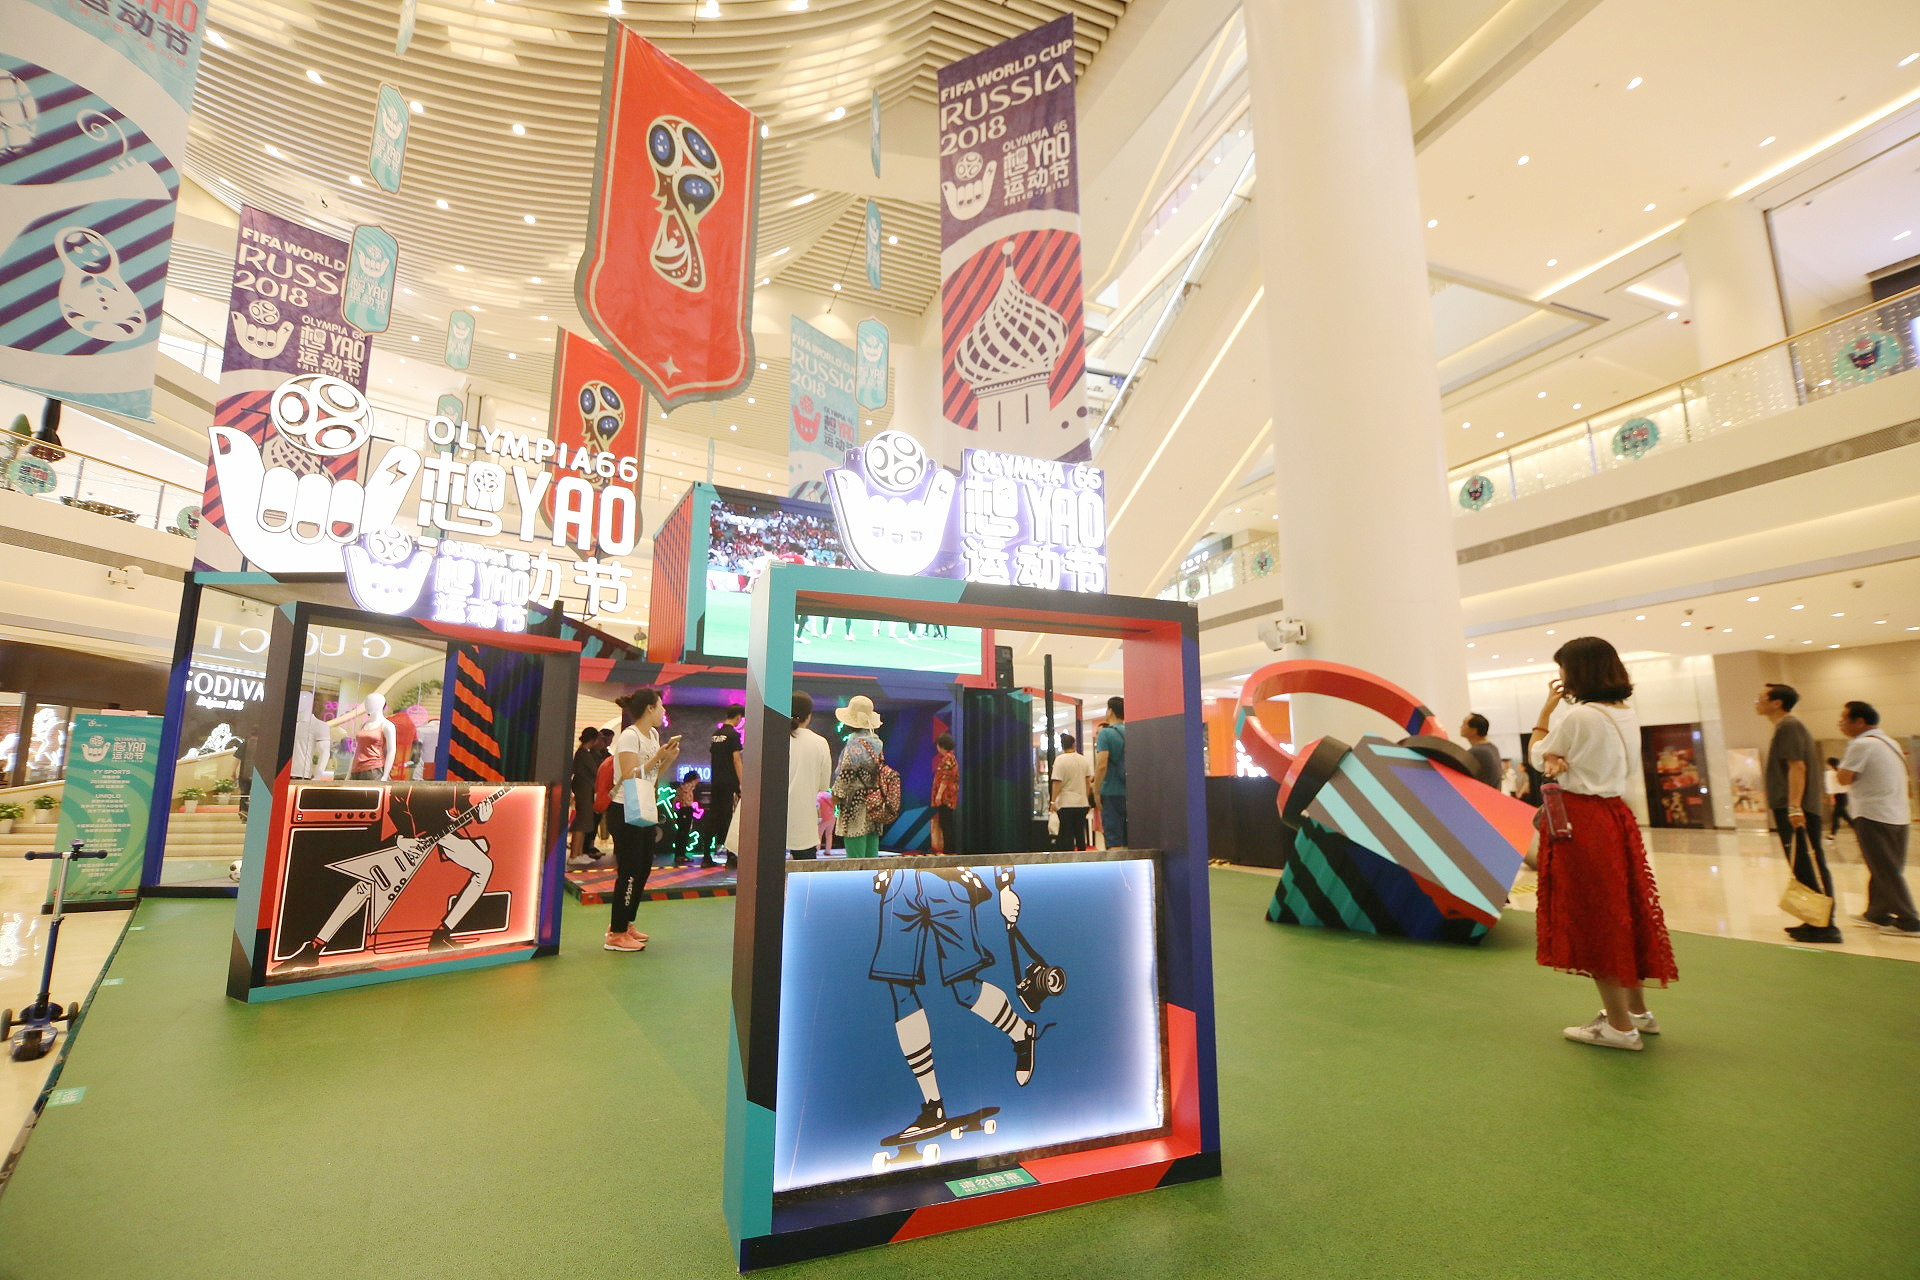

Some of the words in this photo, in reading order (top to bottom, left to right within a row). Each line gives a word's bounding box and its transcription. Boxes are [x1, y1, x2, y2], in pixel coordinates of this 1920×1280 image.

[941, 80, 975, 103] FIFA
[976, 54, 1037, 88] WORLD
[1039, 39, 1073, 62] CUP
[941, 62, 1072, 131] RUSSIA
[941, 115, 1007, 156] 2018
[1002, 127, 1050, 152] OLYMPIA
[1004, 159, 1070, 199] 运动节
[242, 227, 282, 251] FIFA
[284, 241, 346, 272] WORLD
[234, 269, 308, 308] 2018
[302, 315, 348, 336] OLYMPIA
[298, 348, 362, 377] 运动节
[792, 347, 855, 393] RUSSIA
[791, 369, 826, 399] 2018
[971, 450, 1066, 487] OLYMPIA
[1072, 461, 1102, 490] 66
[962, 536, 1106, 593] 运动节
